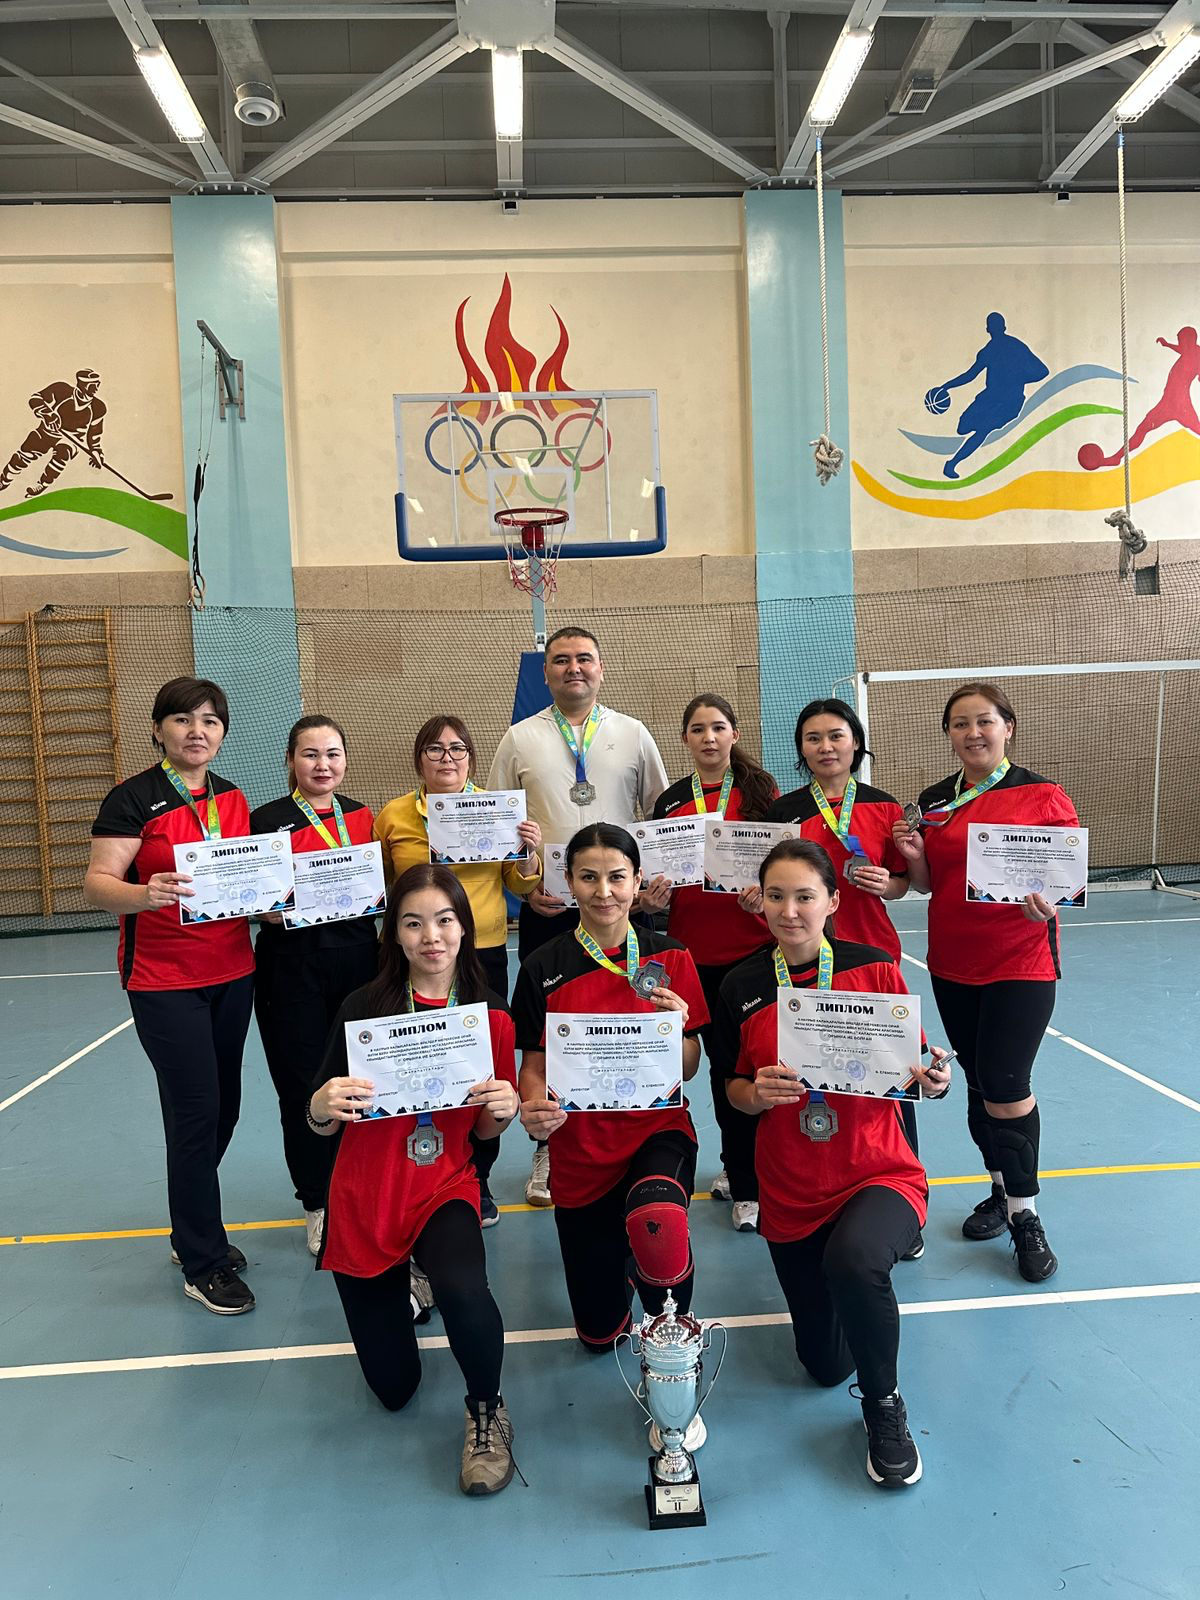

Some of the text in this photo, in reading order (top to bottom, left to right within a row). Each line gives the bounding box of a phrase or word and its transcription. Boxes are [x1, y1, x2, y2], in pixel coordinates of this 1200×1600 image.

[455, 800, 496, 809] ДИПЛОМ
[656, 824, 695, 836] ДИПЛОМ
[732, 830, 771, 838] ДИПЛОМ
[1002, 834, 1051, 844] ДИПЛОМ
[211, 845, 259, 859] ДИПЛОМ
[308, 855, 352, 868] ДИПЛОМ
[819, 946, 832, 990] LMATY
[815, 1002, 874, 1015] ДИПЛОМ
[388, 1021, 447, 1039] ДИПЛОМ
[585, 1026, 642, 1036] ДИПЛОМ
